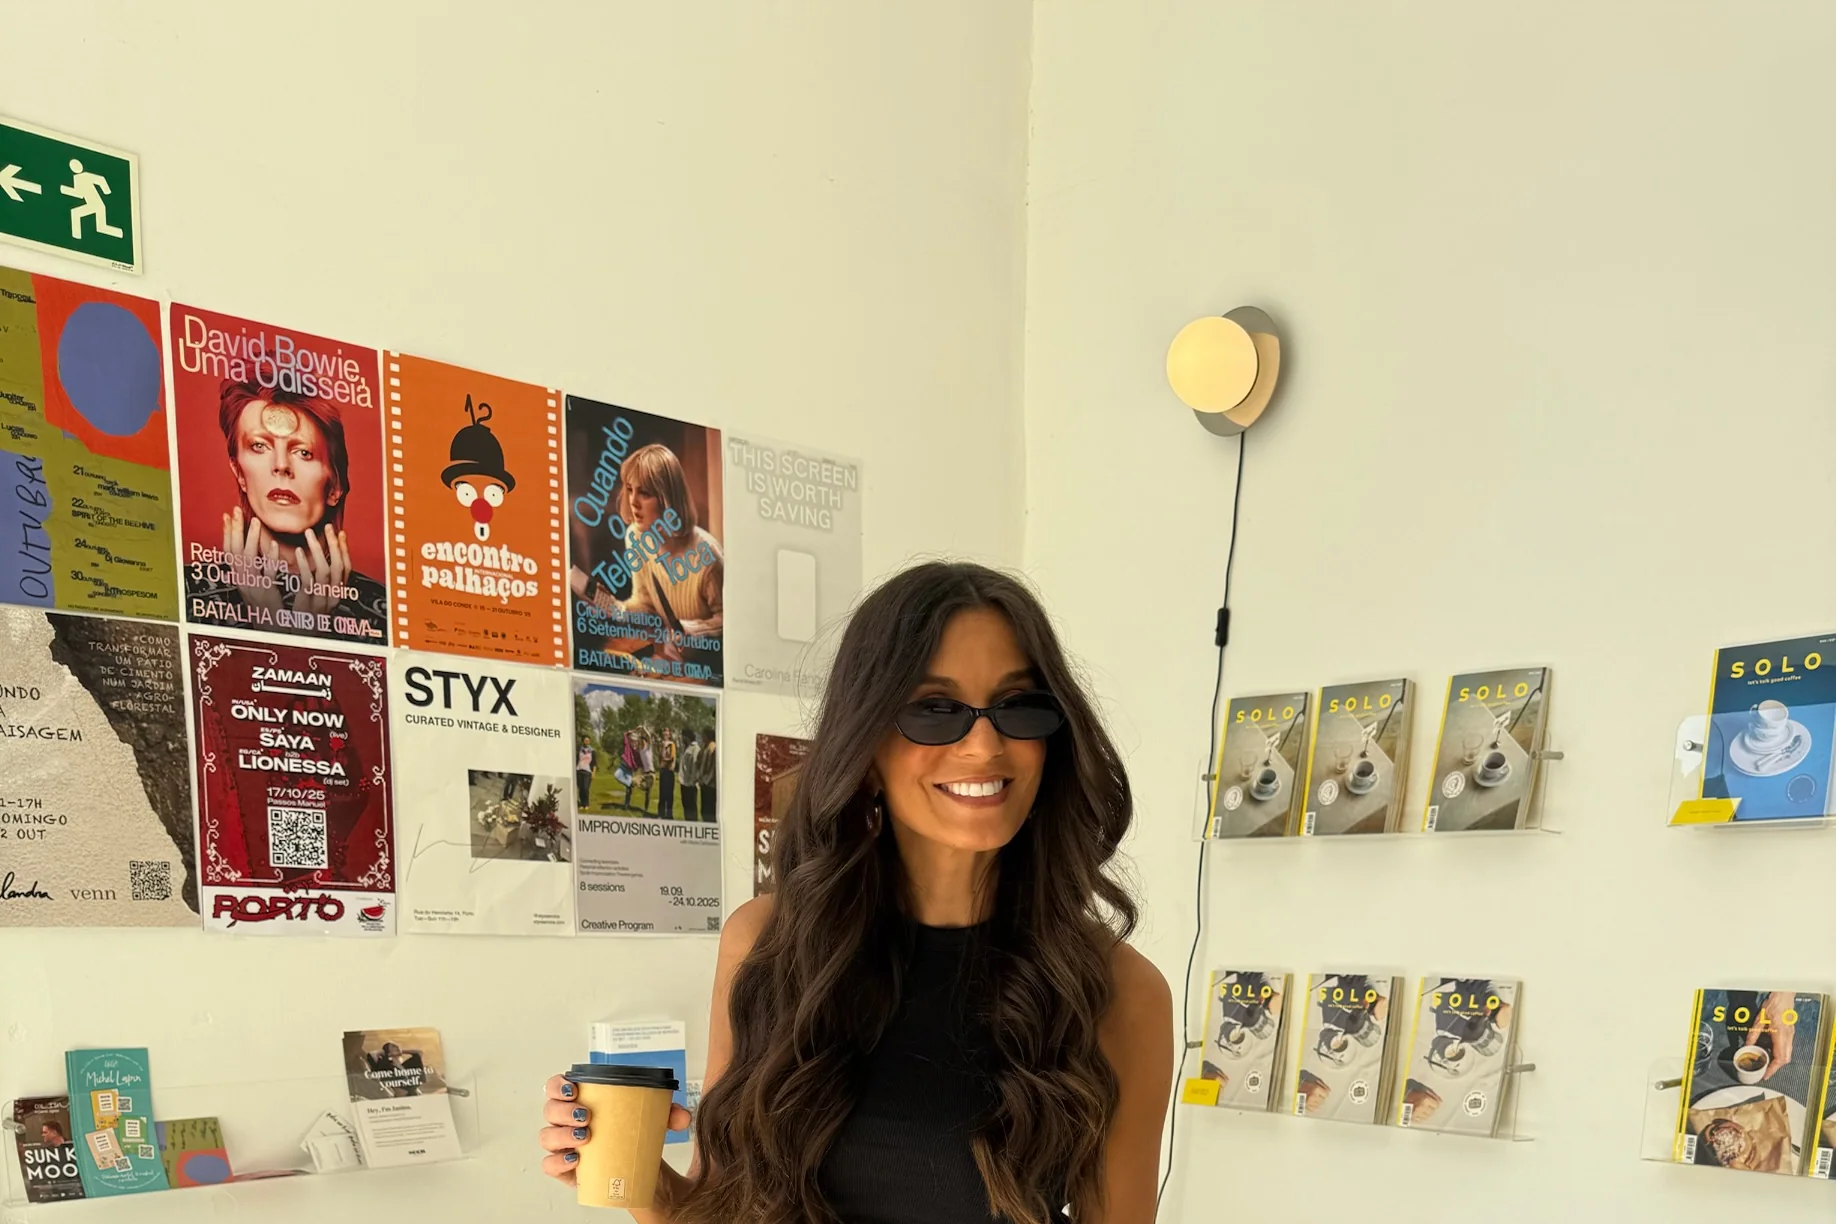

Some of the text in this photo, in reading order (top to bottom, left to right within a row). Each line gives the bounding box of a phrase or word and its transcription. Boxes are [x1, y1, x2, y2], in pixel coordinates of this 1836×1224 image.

[184, 314, 366, 389] David Bowie,
[178, 338, 373, 409] Uma Odisseia
[574, 416, 635, 527] Quando
[730, 442, 856, 489] THIS SCREEN
[748, 471, 842, 509] IS WORTH
[760, 497, 831, 529] SAVING
[190, 542, 289, 574] Retrospetiva
[421, 541, 538, 576] encontro
[591, 507, 682, 595] Telefone
[655, 540, 717, 586] Toca
[191, 561, 203, 581] 3
[304, 577, 359, 601] Janeiro
[421, 565, 539, 605] palhaços
[192, 598, 273, 626] BATALHA
[430, 598, 443, 606] VILA
[453, 602, 472, 610] CONDE
[498, 608, 523, 617] OUTUBRO
[576, 601, 607, 620] Ciclo
[140, 634, 171, 647] COMO
[576, 617, 587, 633] 6
[673, 629, 721, 653] Outubro
[88, 641, 172, 658] TRANSFORMAR
[578, 648, 638, 670] BATALHA
[115, 655, 132, 666] UM
[1730, 652, 1822, 679] SOLO
[100, 665, 173, 680] DE CIMENTO
[251, 666, 332, 687] ZAMAAN
[102, 678, 174, 691] NUM JARDIM
[405, 666, 519, 717] STYX
[1459, 682, 1529, 702] SOLO
[112, 700, 176, 714] FLORESTAL
[1329, 694, 1392, 713] SOLO
[231, 705, 344, 729] ONLY NOW
[1236, 706, 1295, 724] SOLO
[329, 730, 349, 740] (live)
[405, 714, 561, 738] CURATED VINTAGE & DESIGNER
[259, 732, 316, 751] SAYA
[285, 751, 301, 759] b2b
[238, 753, 346, 777] LIONESSA
[323, 778, 350, 787] (dj set)
[267, 787, 326, 801] 17/10/25
[267, 798, 326, 809] Passos Manuel
[16, 829, 47, 841] OUT
[578, 819, 719, 840] IMPROVISING WITH LIFE
[70, 888, 117, 901] venn
[580, 881, 626, 893] 8 sessions
[212, 893, 345, 923] PORTO
[581, 919, 654, 932] Creative Program
[1220, 983, 1272, 999] SOLO
[1319, 987, 1377, 1004] SOLO
[1432, 992, 1500, 1010] SOLO
[1712, 1006, 1799, 1026] SOLO
[86, 1070, 115, 1087] Michel
[364, 1066, 434, 1080] Come home to
[379, 1076, 423, 1091] yourself.
[24, 1148, 60, 1164] SUN
[26, 1163, 79, 1180] MOO
